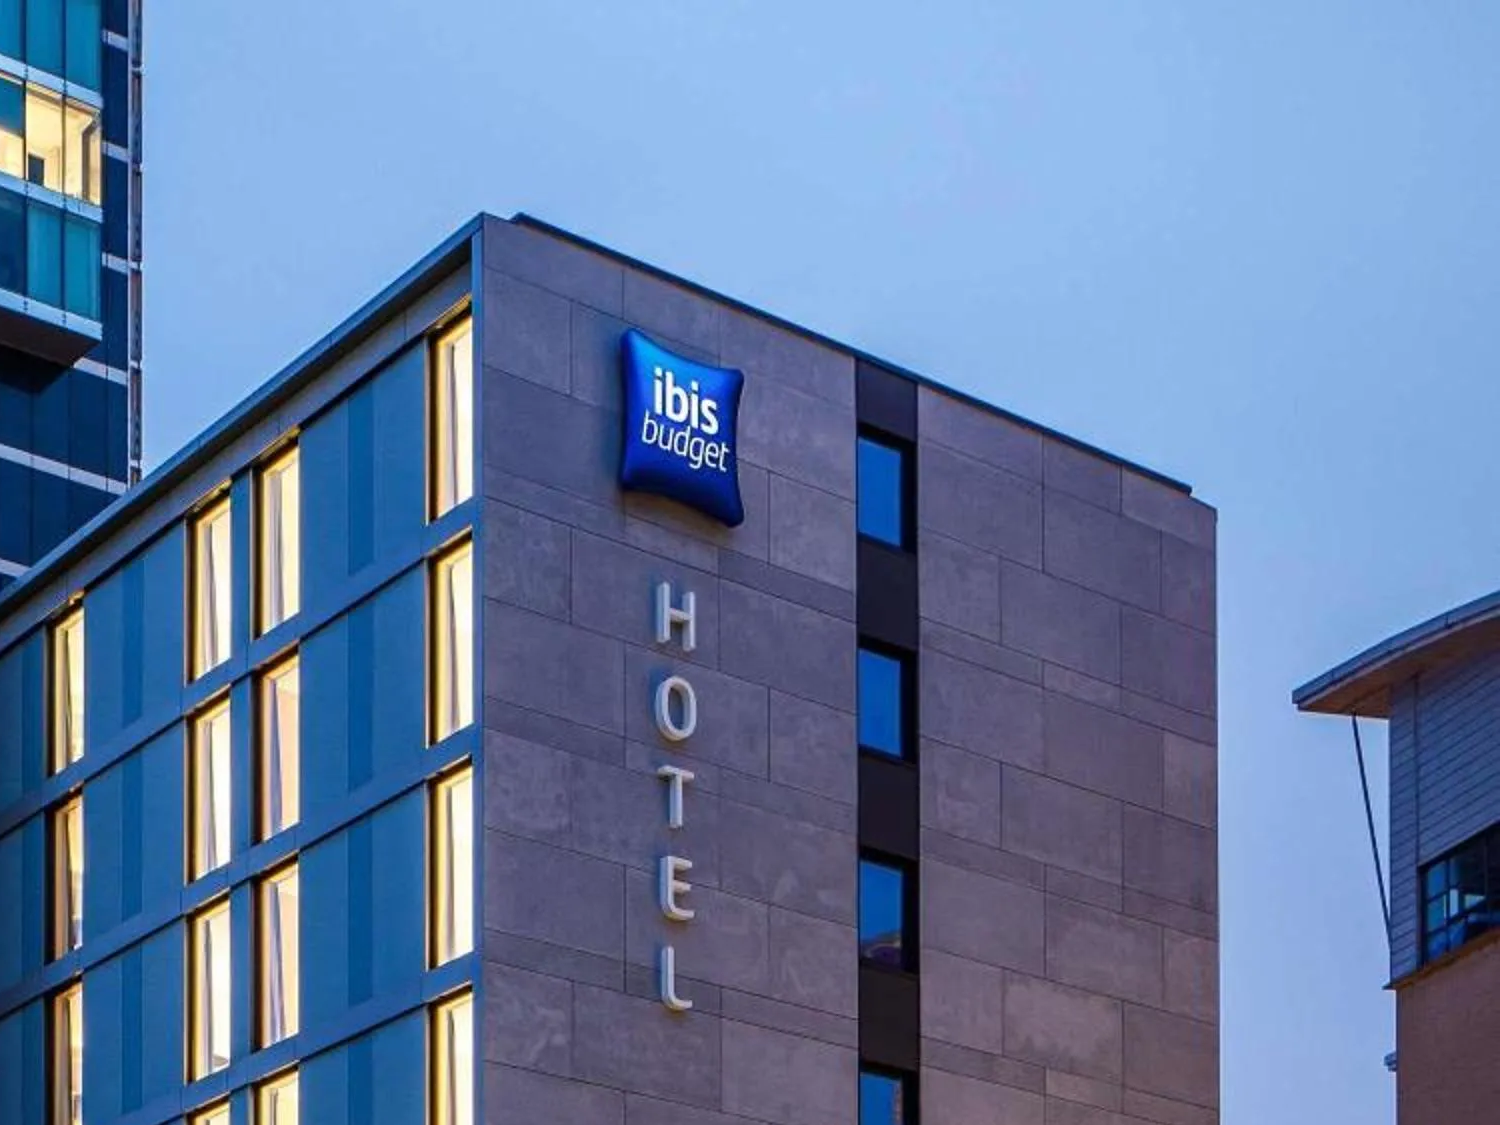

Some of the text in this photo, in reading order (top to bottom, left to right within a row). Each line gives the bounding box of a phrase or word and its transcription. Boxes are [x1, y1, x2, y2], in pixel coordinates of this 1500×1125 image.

[653, 366, 719, 435] ibis
[641, 408, 730, 473] budget
[655, 581, 697, 1012] HOTEL
